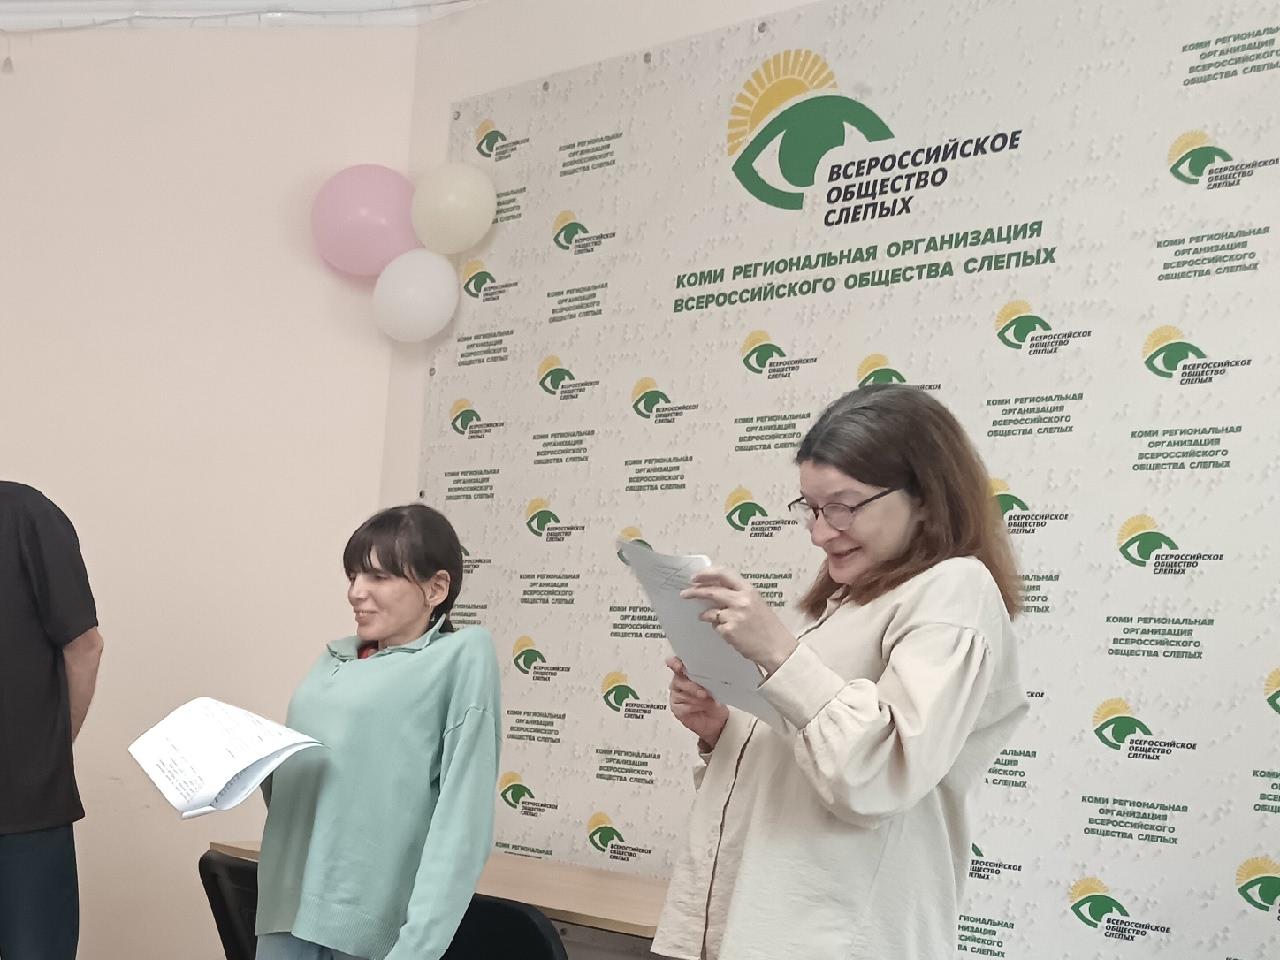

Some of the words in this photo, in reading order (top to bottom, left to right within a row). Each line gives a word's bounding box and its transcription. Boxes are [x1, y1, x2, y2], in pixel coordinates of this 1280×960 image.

[1215, 26, 1280, 45] РЕГИОНАЛЬ
[1243, 62, 1280, 74] СЛЕПЫ
[828, 130, 1022, 182] ВСЕРОССИЙСКОЕ
[827, 168, 948, 204] ОБЩЕСТВО
[824, 196, 914, 227] СЛЕПЫХ
[1157, 238, 1185, 248] КОМИ
[1189, 226, 1270, 244] РЕГИОНАЛЬНАЯ
[1175, 241, 1248, 256] ОРГАНИЗАЦИЯ
[676, 269, 725, 288] КОМИ
[732, 245, 877, 280] РЕГИОНАЛЬНАЯ
[886, 221, 1043, 257] ОРГАНИЗАЦИЯ
[1163, 252, 1256, 270] ВСЕРОССИЙСКОГО
[1158, 269, 1210, 281] ОБЩЕСТВА
[1215, 263, 1260, 274] СЛЕПЫХ
[673, 277, 835, 313] ВСЕРОССИЙСКОГО
[844, 259, 953, 291] ОБЩЕСТВА
[963, 247, 1057, 275] СЛЕПЫХ
[1182, 360, 1252, 370] ВСЕРОССИЙСКОЕ
[1181, 369, 1226, 377] ОБЩЕСТВО
[1180, 377, 1213, 385] СЛЕПЫХ
[1014, 393, 1083, 404] РЕГИОНАЛЬНАЯ
[1002, 406, 1064, 415] ОРГАНИЗАЦИЯ
[992, 415, 1071, 426] ВСЕРОССИЙСКОГО
[987, 429, 1032, 437] ОБЩЕСТВА
[1037, 426, 1074, 434] СЛЕПЫХ
[1131, 430, 1158, 438] КОМИ
[1162, 426, 1242, 436] РЕГИОНАЛЬНАЯ
[1148, 438, 1220, 448] ОРГАНИЗАЦИЯ
[1138, 450, 1228, 460] ВСЕРОССИЙСКОГО
[1132, 462, 1185, 471] ОБЩЕСТВА
[1190, 461, 1230, 469] СЛЕПЫХ
[1137, 617, 1214, 625] РЕГИОНАЛЬНАЯ
[1123, 628, 1193, 636] ОРГАНИЗАЦИЯ
[1113, 638, 1201, 647] ВСЕРОССИЙСКОГО
[1108, 649, 1159, 657] ОБЩЕСТВА
[1163, 651, 1203, 659] СЛЕПЫХ
[1129, 746, 1172, 754] ОБЩЕСТВО
[1130, 739, 1197, 750] ВСЕРОССИЙСКОЕ
[1000, 749, 1036, 758] АЛЬНАЯ
[993, 779, 1027, 788] СЛЕПЫХ
[1082, 796, 1108, 804] КОМИ
[1113, 798, 1188, 812] РЕГИОНАЛЬНАЯ
[1099, 808, 1167, 821] ОРГАНИЗАЦИЯ
[1089, 818, 1175, 833] ВСЕРОССИЙСКОГО
[1084, 827, 1133, 839] ОБЩЕСТВА
[1138, 834, 1178, 844] СЛЕПЫХ
[970, 866, 1000, 874] ЩЕСТВО
[971, 860, 1022, 871] ЕРОССИЙСКОЕ
[959, 915, 1014, 929] ГИОНАЛЬНАЯ
[1106, 918, 1171, 933] ВСЕРОССИЙСКОЕ
[958, 925, 996, 936] НИЗАЦИЯ
[1106, 925, 1147, 936] ОБЩЕСТВО
[959, 934, 1003, 947] СИЙСКОГО
[1105, 932, 1135, 941] СЛЕПЫХ
[971, 947, 1005, 958] СЛЕПЫХ
